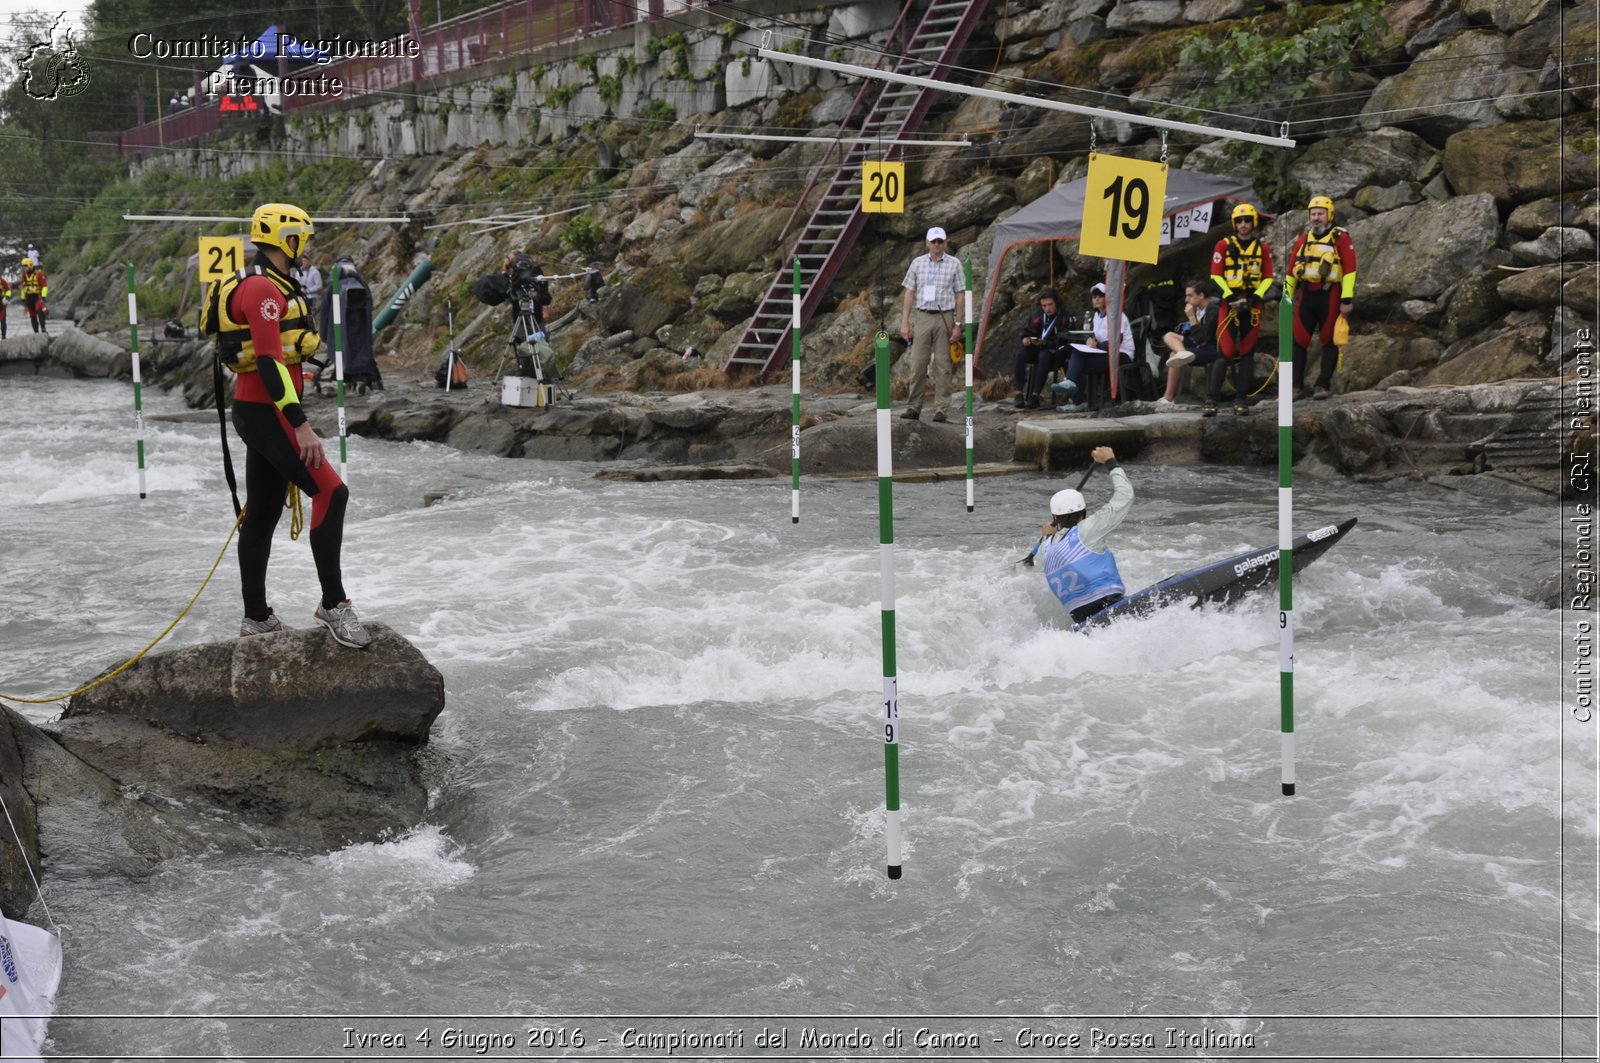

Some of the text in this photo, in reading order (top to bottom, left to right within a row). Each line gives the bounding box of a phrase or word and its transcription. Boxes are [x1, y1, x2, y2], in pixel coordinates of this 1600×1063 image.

[869, 171, 899, 202] 20
[1103, 175, 1149, 239] 19
[1193, 209, 1209, 223] 24
[1161, 222, 1169, 235] 2
[1176, 215, 1190, 228] 23
[208, 246, 236, 273] 21
[1306, 525, 1339, 542] team
[1234, 549, 1280, 577] galaspor
[1051, 570, 1085, 597] 22
